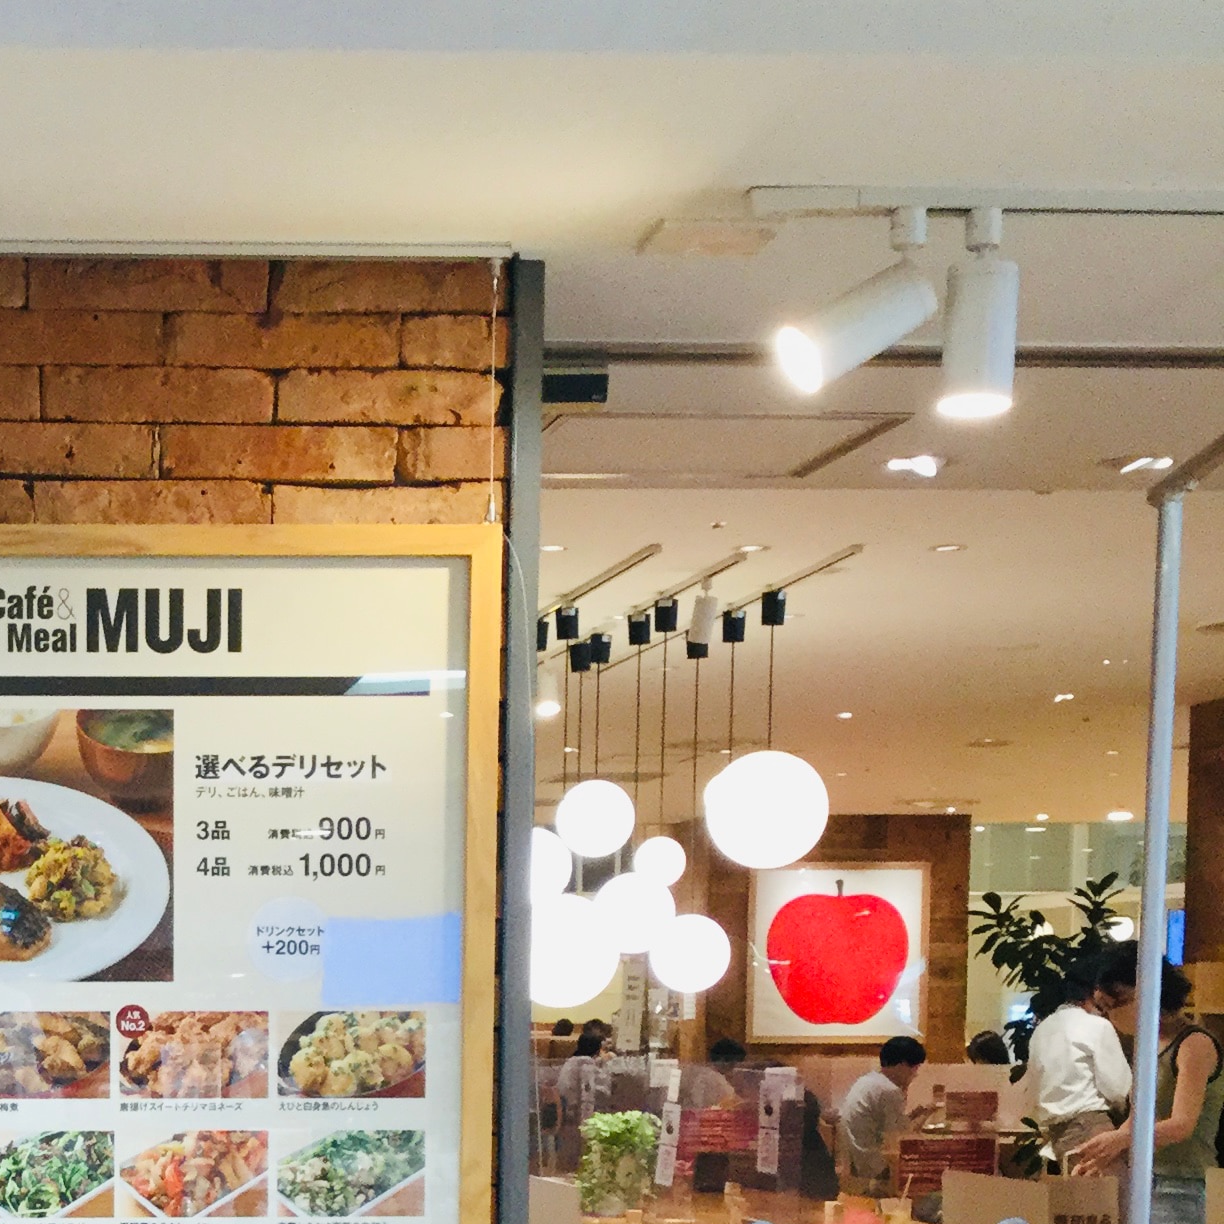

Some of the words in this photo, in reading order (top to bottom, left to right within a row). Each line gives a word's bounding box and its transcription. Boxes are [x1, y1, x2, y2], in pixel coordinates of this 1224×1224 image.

[86, 588, 243, 654] MUJI
[7, 623, 77, 653] Meal
[195, 754, 387, 780] 選べるデリセット
[196, 820, 231, 840] 3品
[196, 857, 231, 877] 4品
[256, 925, 325, 937] ドリンクセット
[261, 940, 320, 955] +200円
